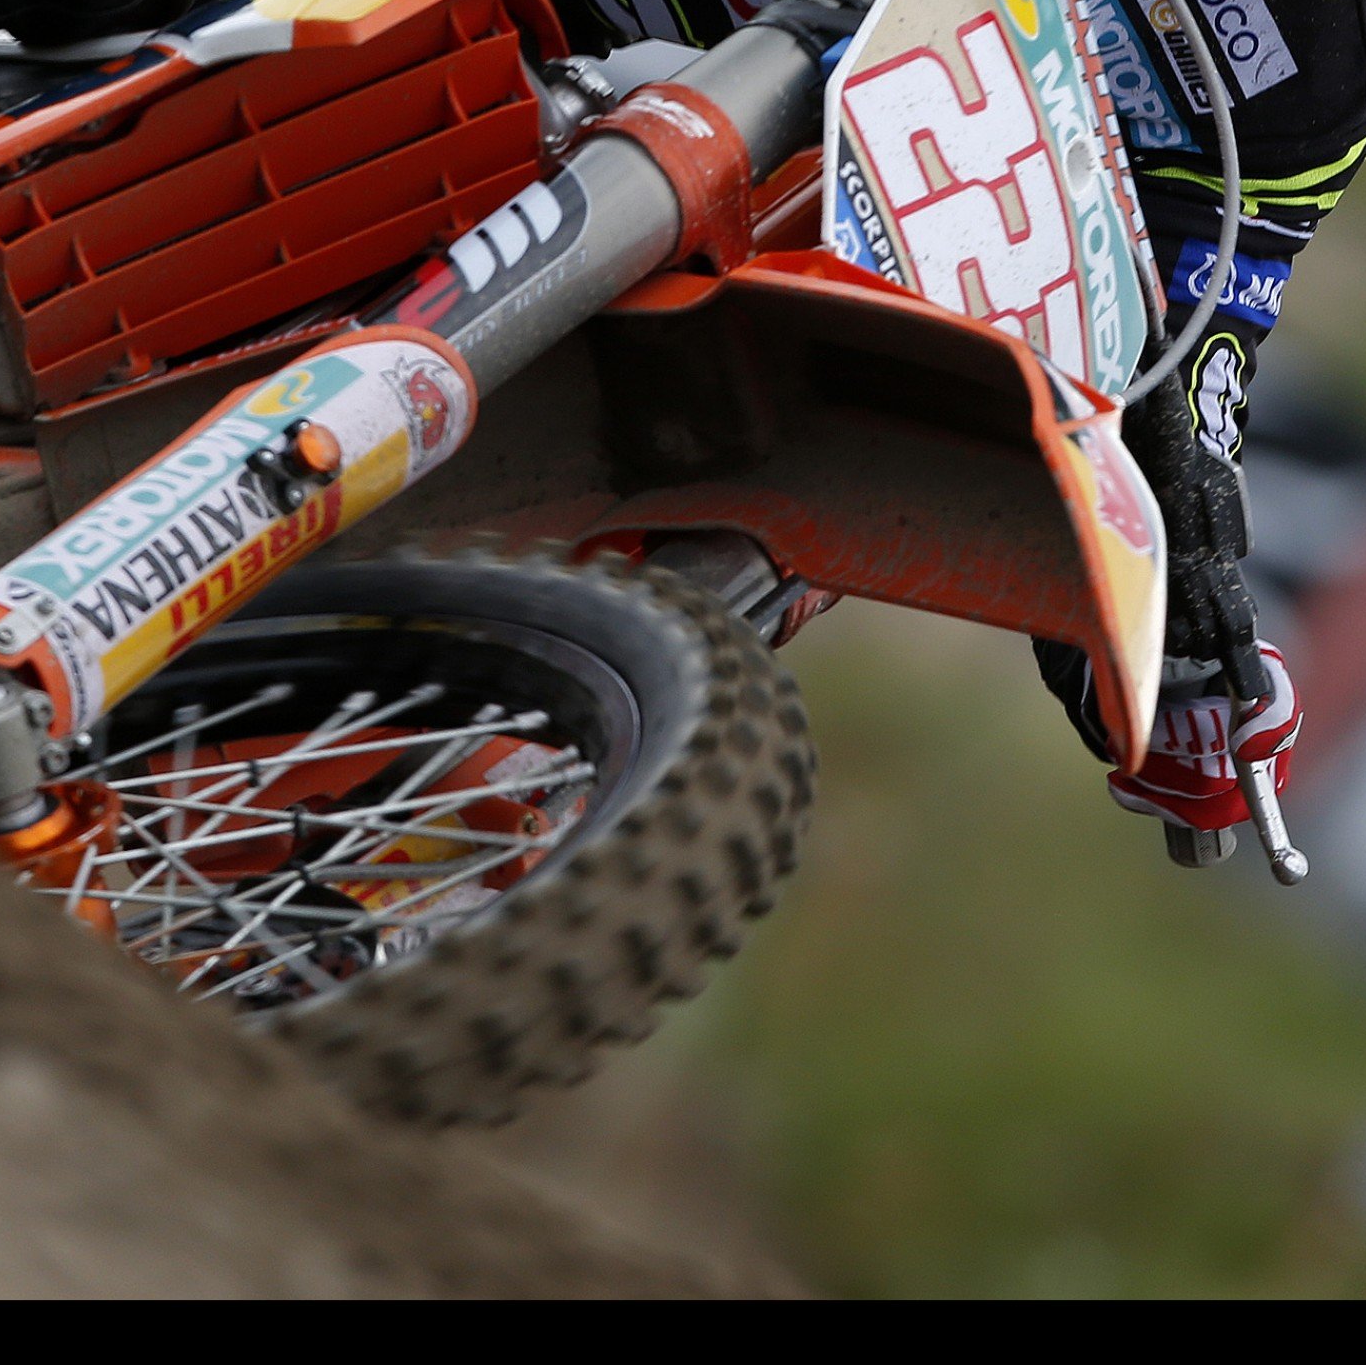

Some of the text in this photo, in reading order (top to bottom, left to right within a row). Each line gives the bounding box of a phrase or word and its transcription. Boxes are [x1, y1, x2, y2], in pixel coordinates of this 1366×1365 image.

[19, 417, 273, 585] MOTOREX
[71, 487, 259, 643] ATHENA
[163, 481, 343, 659] PIRELLI
